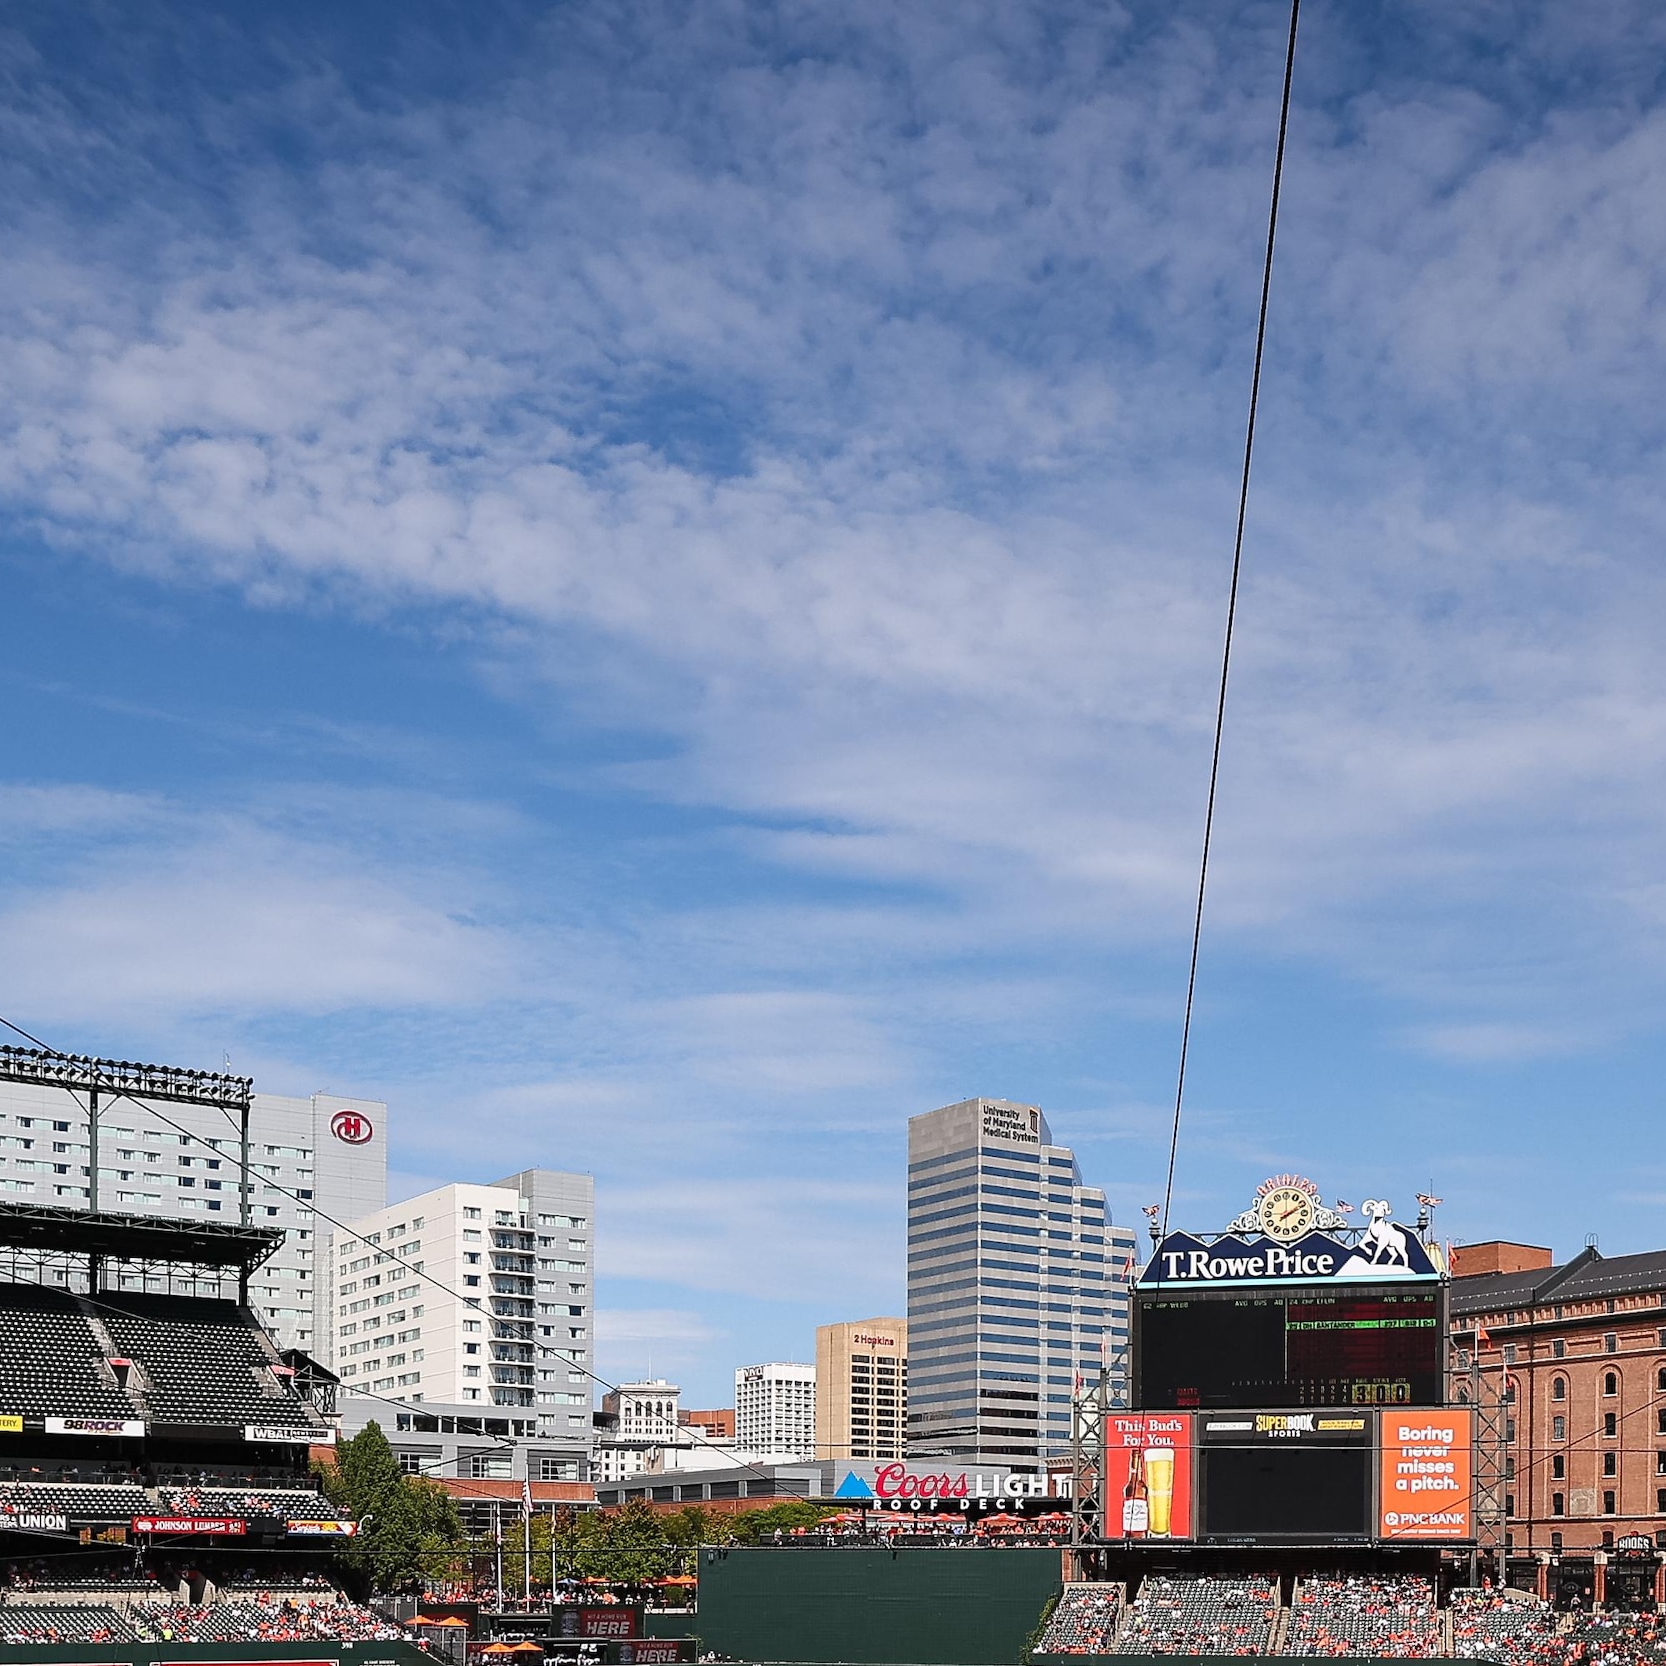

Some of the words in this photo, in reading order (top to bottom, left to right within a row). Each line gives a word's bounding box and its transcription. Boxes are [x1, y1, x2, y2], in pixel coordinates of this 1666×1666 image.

[1115, 1420, 1145, 1432] This
[1148, 1420, 1182, 1432] Bud's
[1256, 1414, 1314, 1431] SUPERBOOK
[254, 1428, 290, 1439] WBAL
[1123, 1434, 1144, 1446] For
[1147, 1434, 1174, 1446] You.
[1398, 1426, 1453, 1443] Boring
[1402, 1446, 1450, 1457] never
[1397, 1459, 1454, 1473] misses
[874, 1462, 969, 1498] Coors
[1395, 1479, 1407, 1490] a
[1410, 1475, 1459, 1493] pitch.
[874, 1499, 938, 1510] ROOF
[960, 1498, 1025, 1510] DECK
[20, 1514, 66, 1530] UNION
[154, 1521, 192, 1530] JOHNSON
[586, 1621, 630, 1635] HERE
[635, 1649, 677, 1662] HERE
